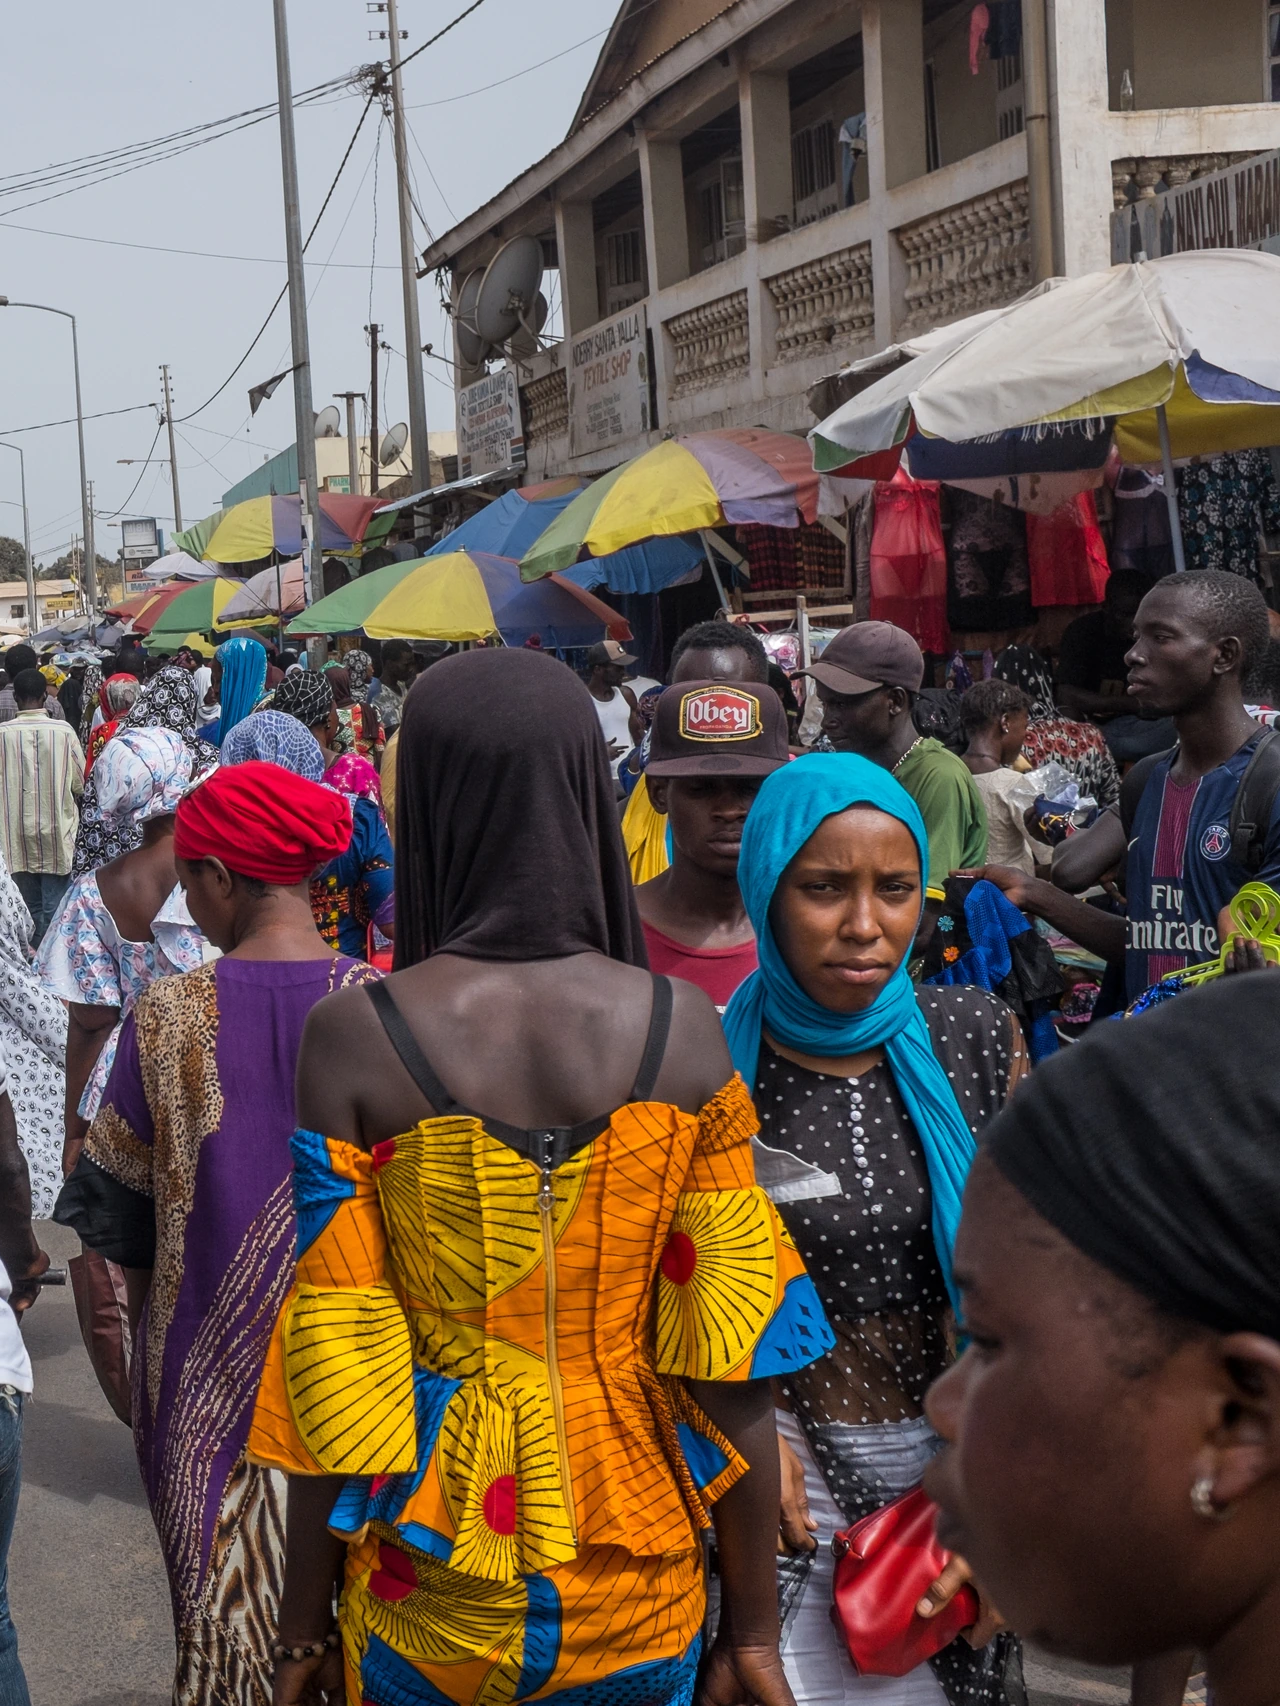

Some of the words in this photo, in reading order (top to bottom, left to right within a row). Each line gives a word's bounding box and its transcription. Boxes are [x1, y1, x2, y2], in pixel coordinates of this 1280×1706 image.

[595, 326, 616, 357] SANTA
[617, 313, 640, 346] YALLA
[583, 359, 609, 392] TEXTILE
[611, 349, 632, 380] SHOP
[690, 698, 747, 730] Obey
[1208, 827, 1228, 838] PARIS
[1151, 884, 1184, 915] Fly
